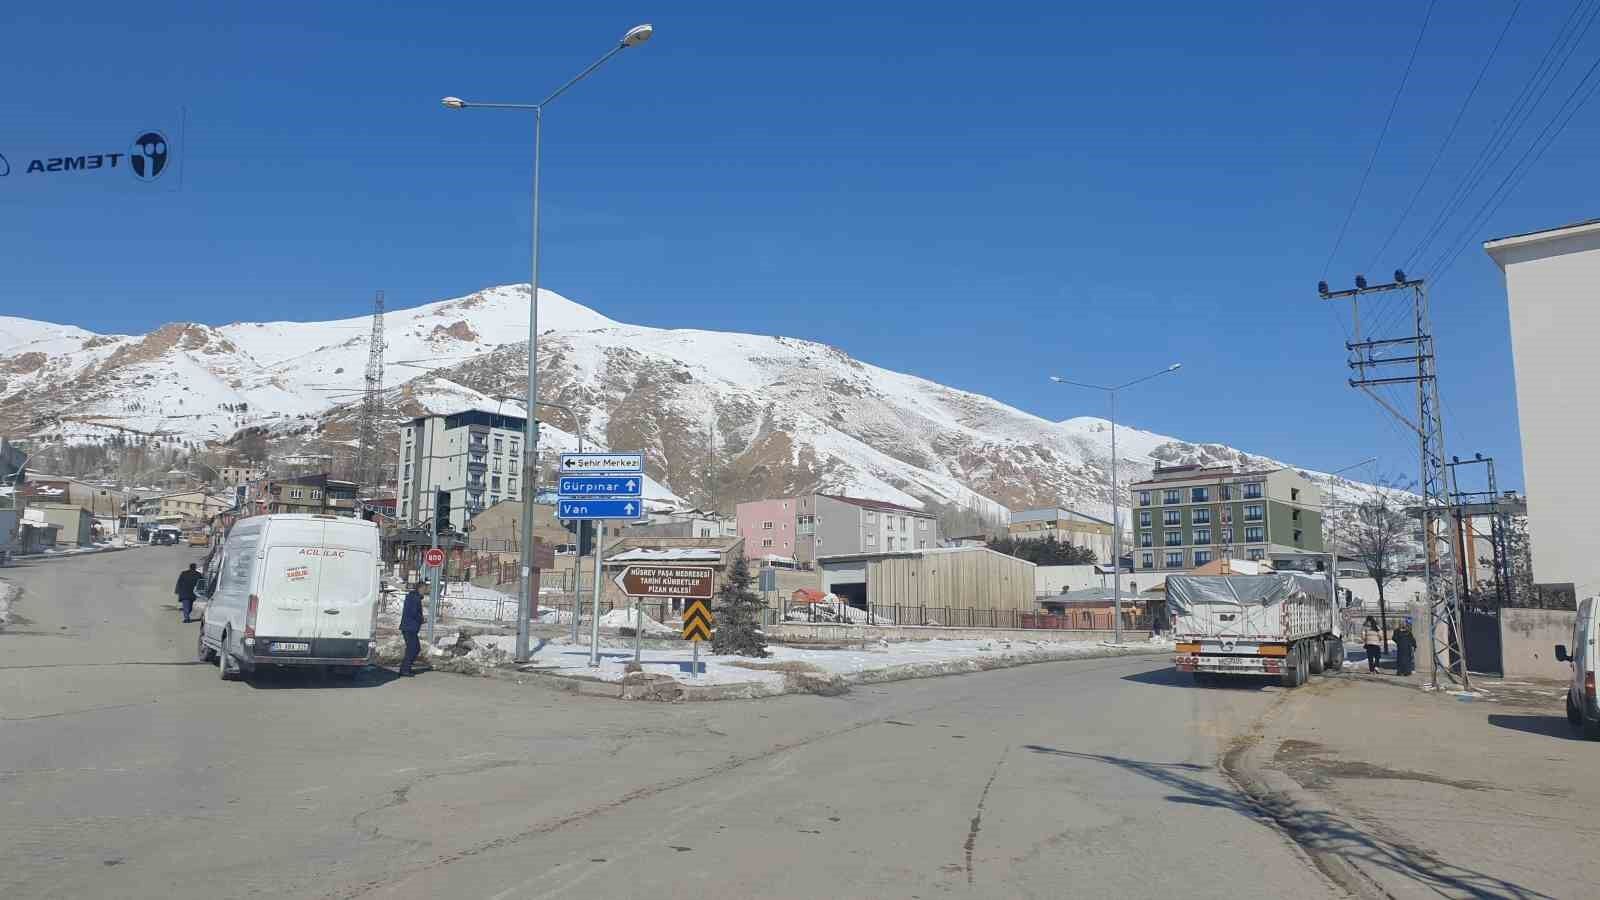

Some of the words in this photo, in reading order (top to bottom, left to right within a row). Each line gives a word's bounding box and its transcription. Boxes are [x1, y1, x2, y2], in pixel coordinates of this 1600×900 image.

[603, 458, 640, 467] Merkezi
[563, 481, 620, 492] Gürpınar
[563, 504, 588, 514] Van
[657, 569, 673, 578] PAŞA
